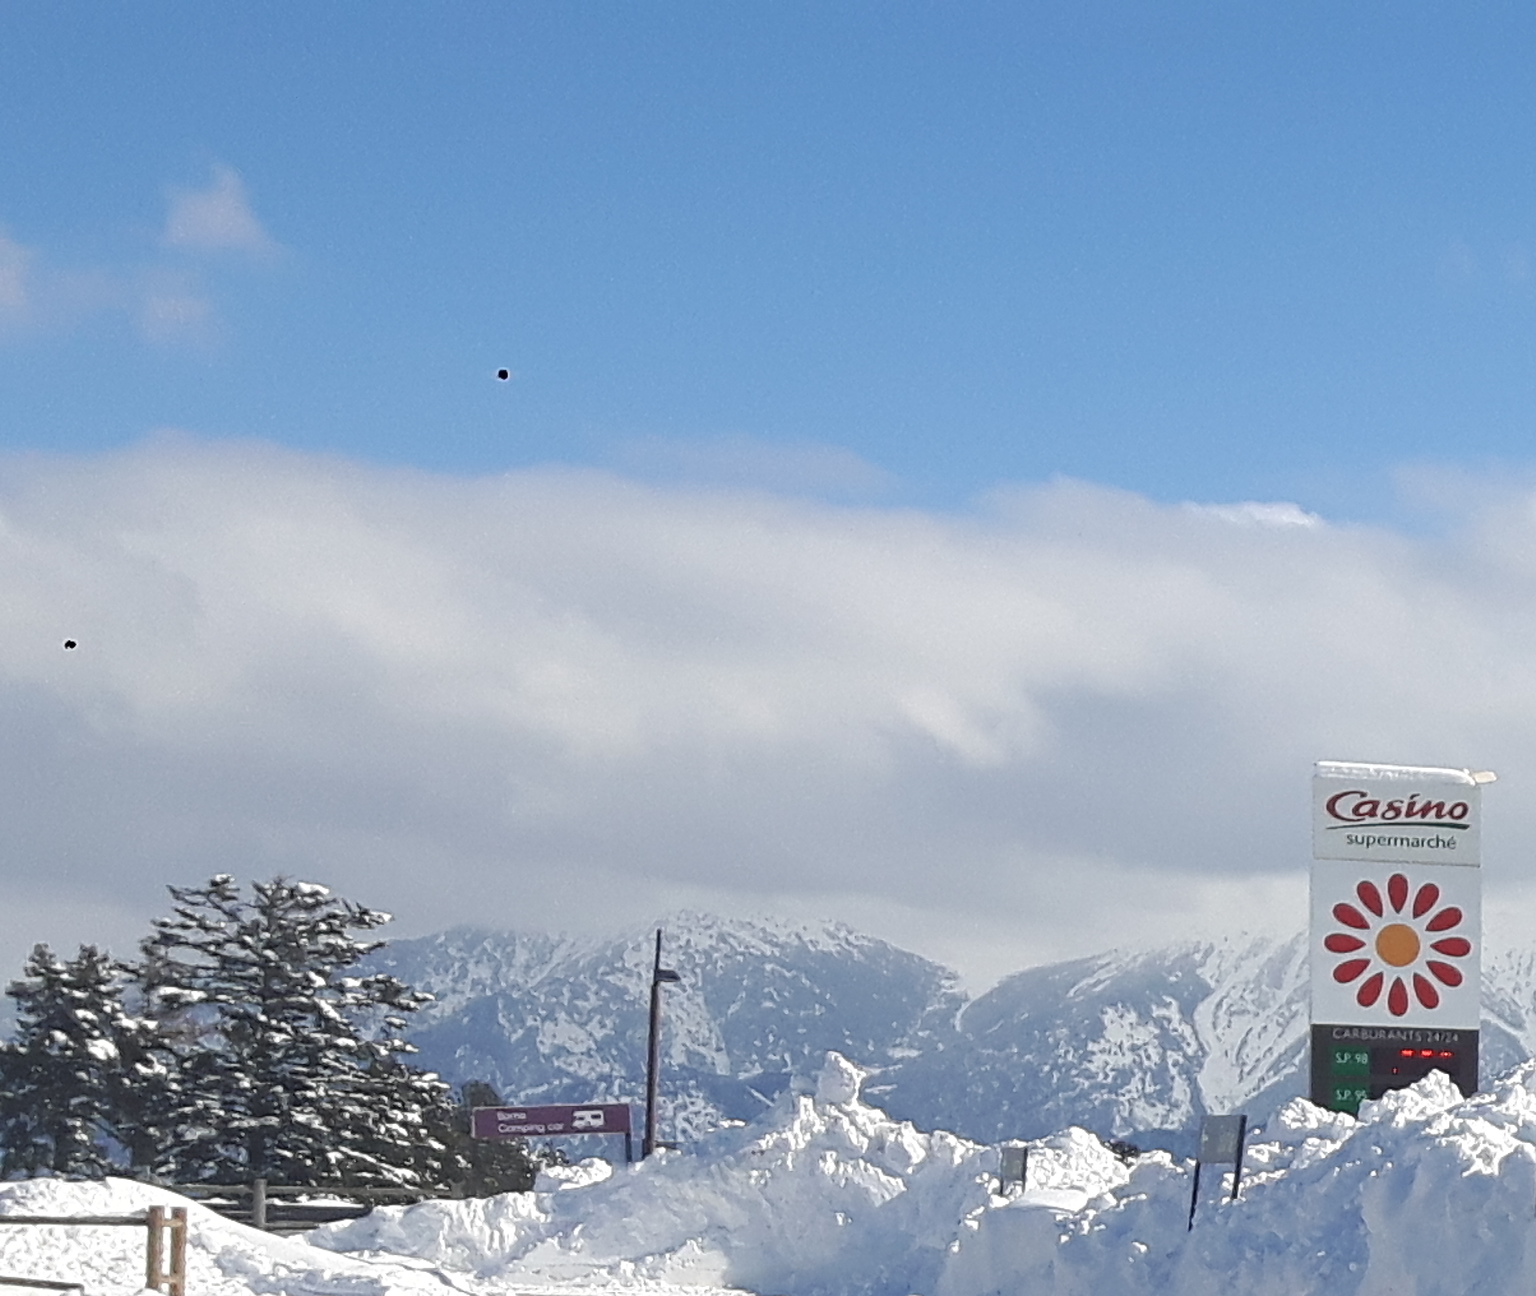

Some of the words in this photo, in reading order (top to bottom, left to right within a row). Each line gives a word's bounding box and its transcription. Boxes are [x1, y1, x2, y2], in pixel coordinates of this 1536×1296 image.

[1326, 790, 1469, 823] Casino
[1346, 834, 1457, 850] supermarché
[1332, 1028, 1422, 1042] CARBURANTS
[1427, 1030, 1459, 1043] 24/24
[1354, 1053, 1368, 1065] 98
